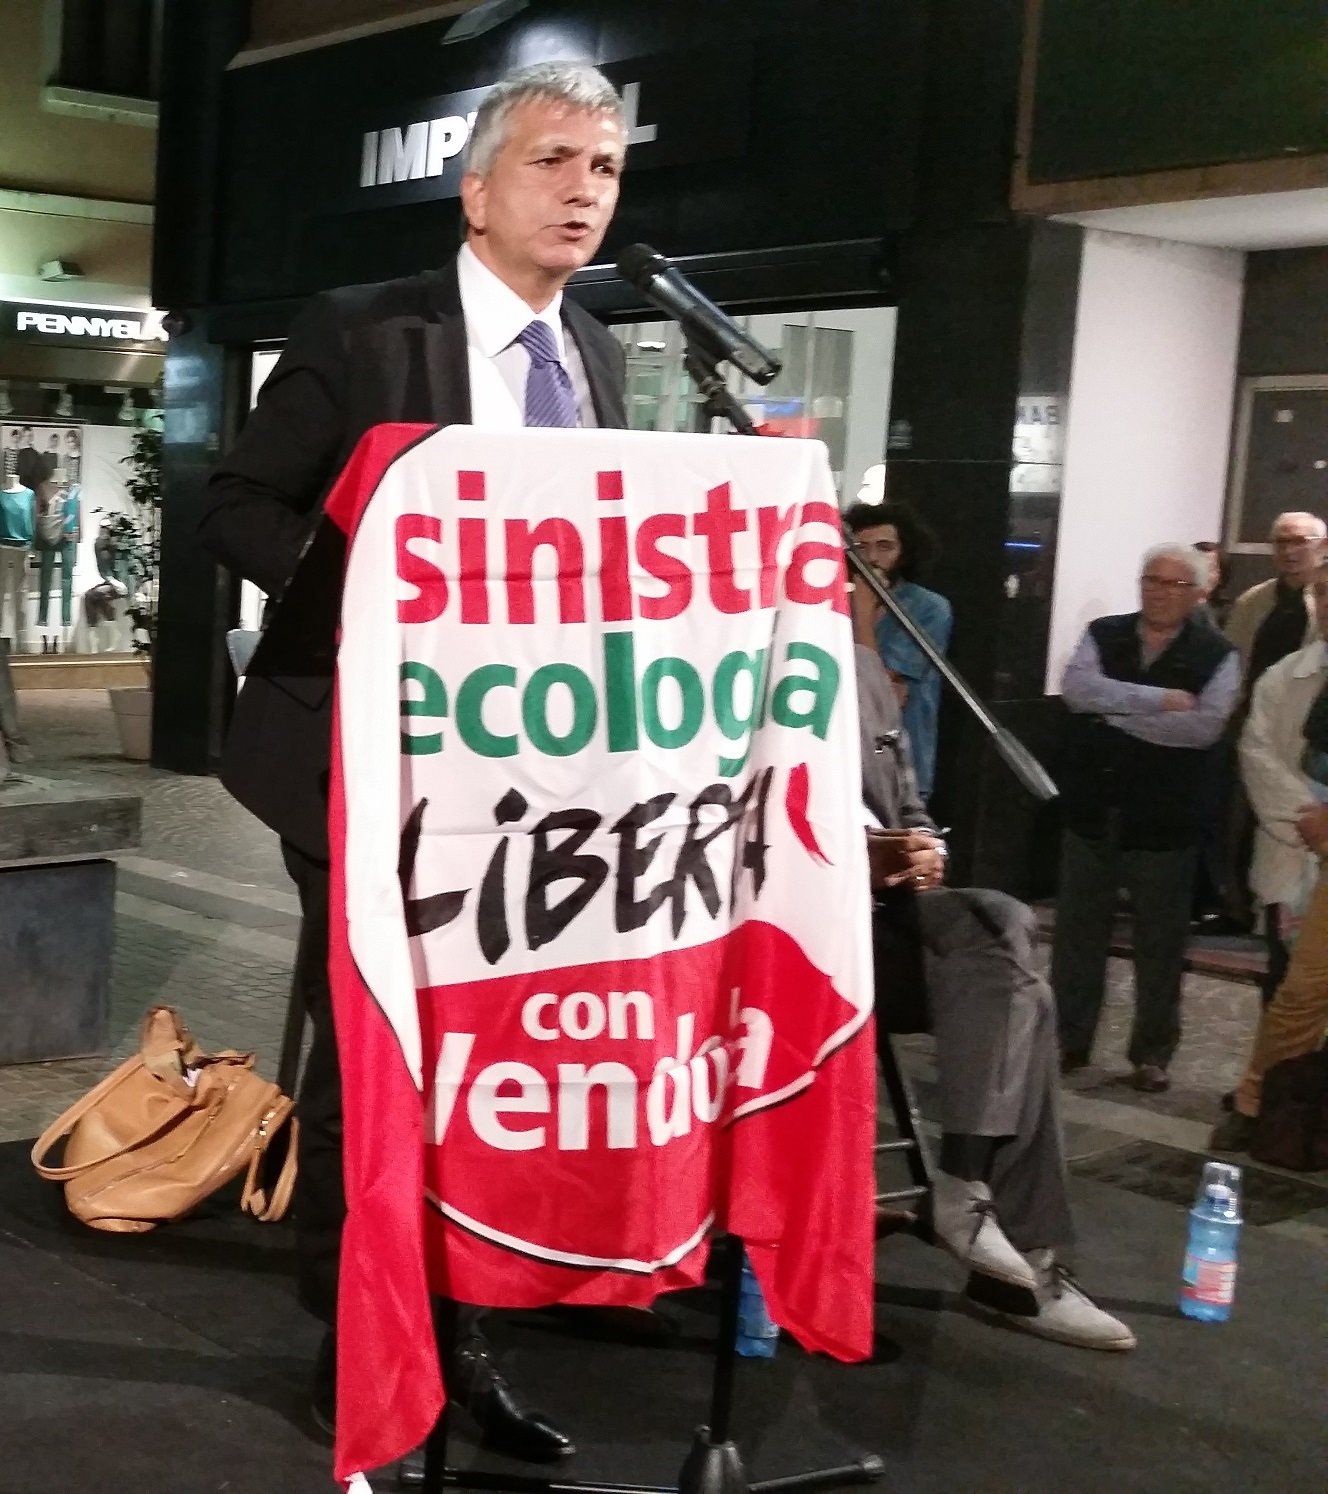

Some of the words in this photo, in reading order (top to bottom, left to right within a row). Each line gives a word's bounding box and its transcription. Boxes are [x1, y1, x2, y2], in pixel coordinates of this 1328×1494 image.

[360, 82, 658, 188] IMPL
[16, 311, 170, 342] PENNYBLA
[394, 470, 852, 624] sinistra
[399, 631, 840, 778] ecologa
[423, 986, 775, 1151] Vendoa
[521, 990, 656, 1041] con
